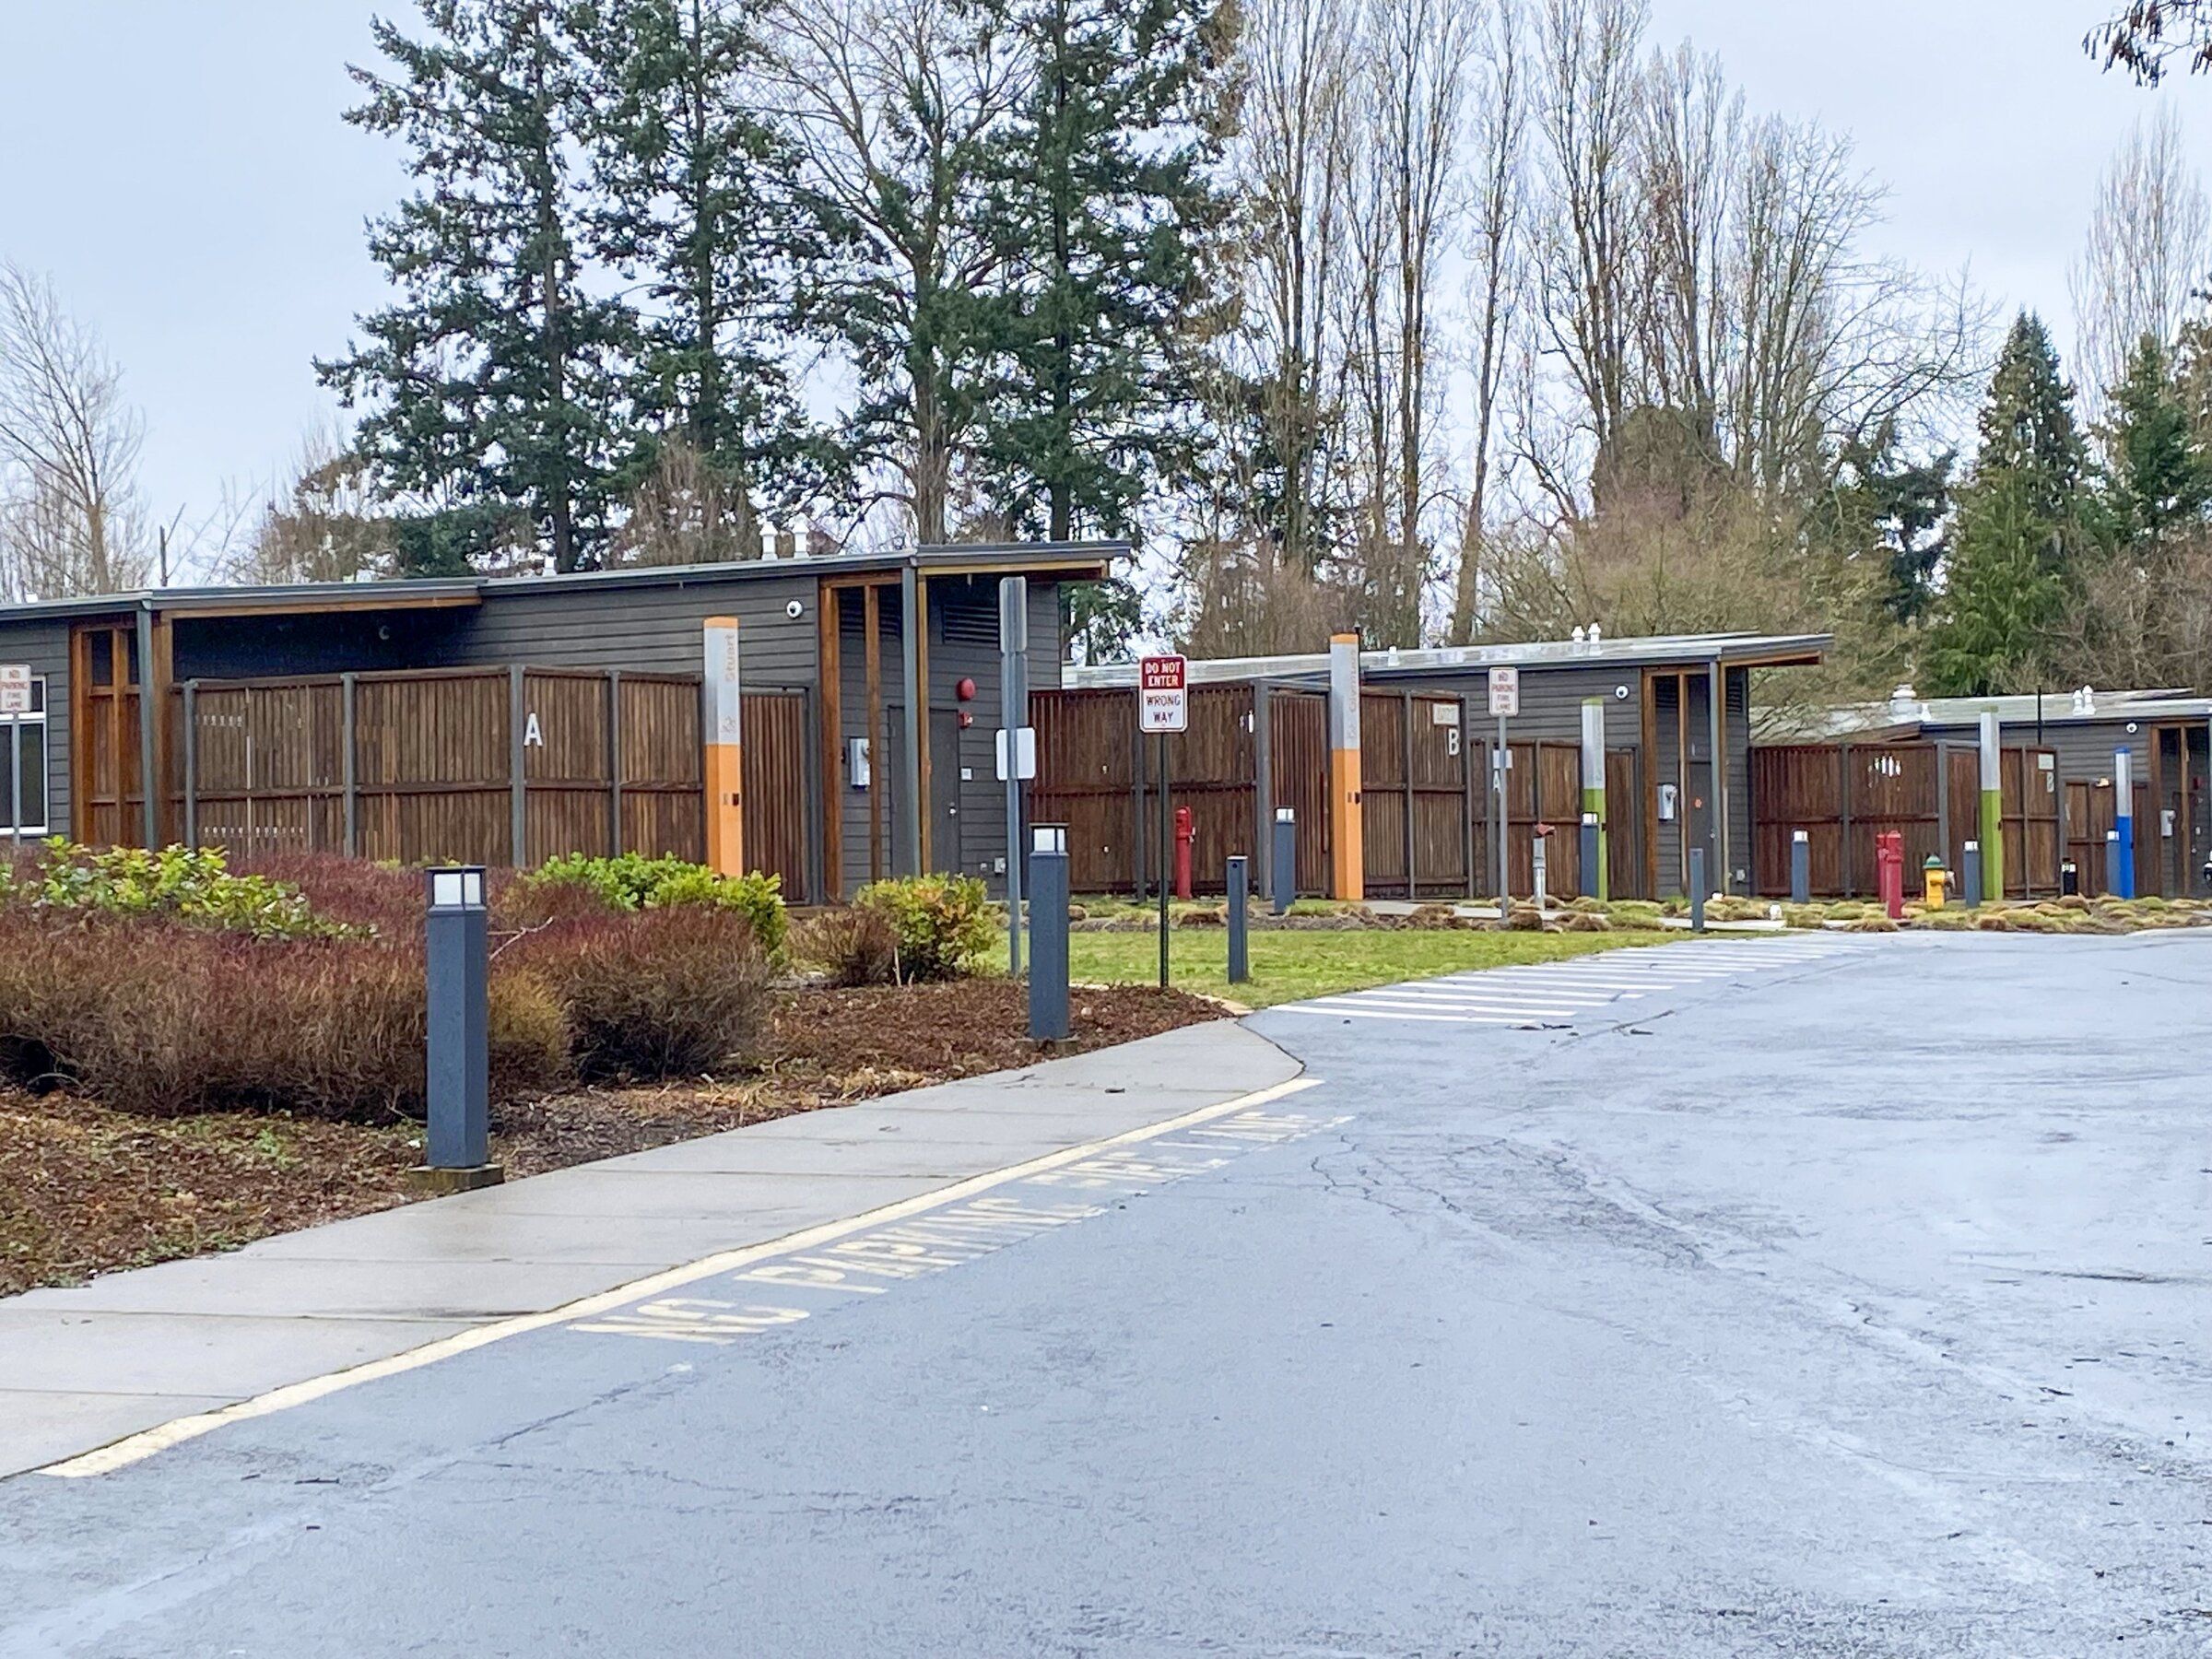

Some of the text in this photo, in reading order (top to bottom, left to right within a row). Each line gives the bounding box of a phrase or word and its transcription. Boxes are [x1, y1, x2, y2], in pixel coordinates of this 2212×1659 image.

[1145, 662, 1181, 674] DO NOT
[1147, 675, 1179, 688] ENTER
[1147, 695, 1181, 707] WRONG
[1153, 712, 1173, 723] WAY
[524, 712, 543, 747] A
[1448, 728, 1460, 756] B
[566, 1298, 811, 1346] NO
[733, 1198, 1110, 1294] PARKING
